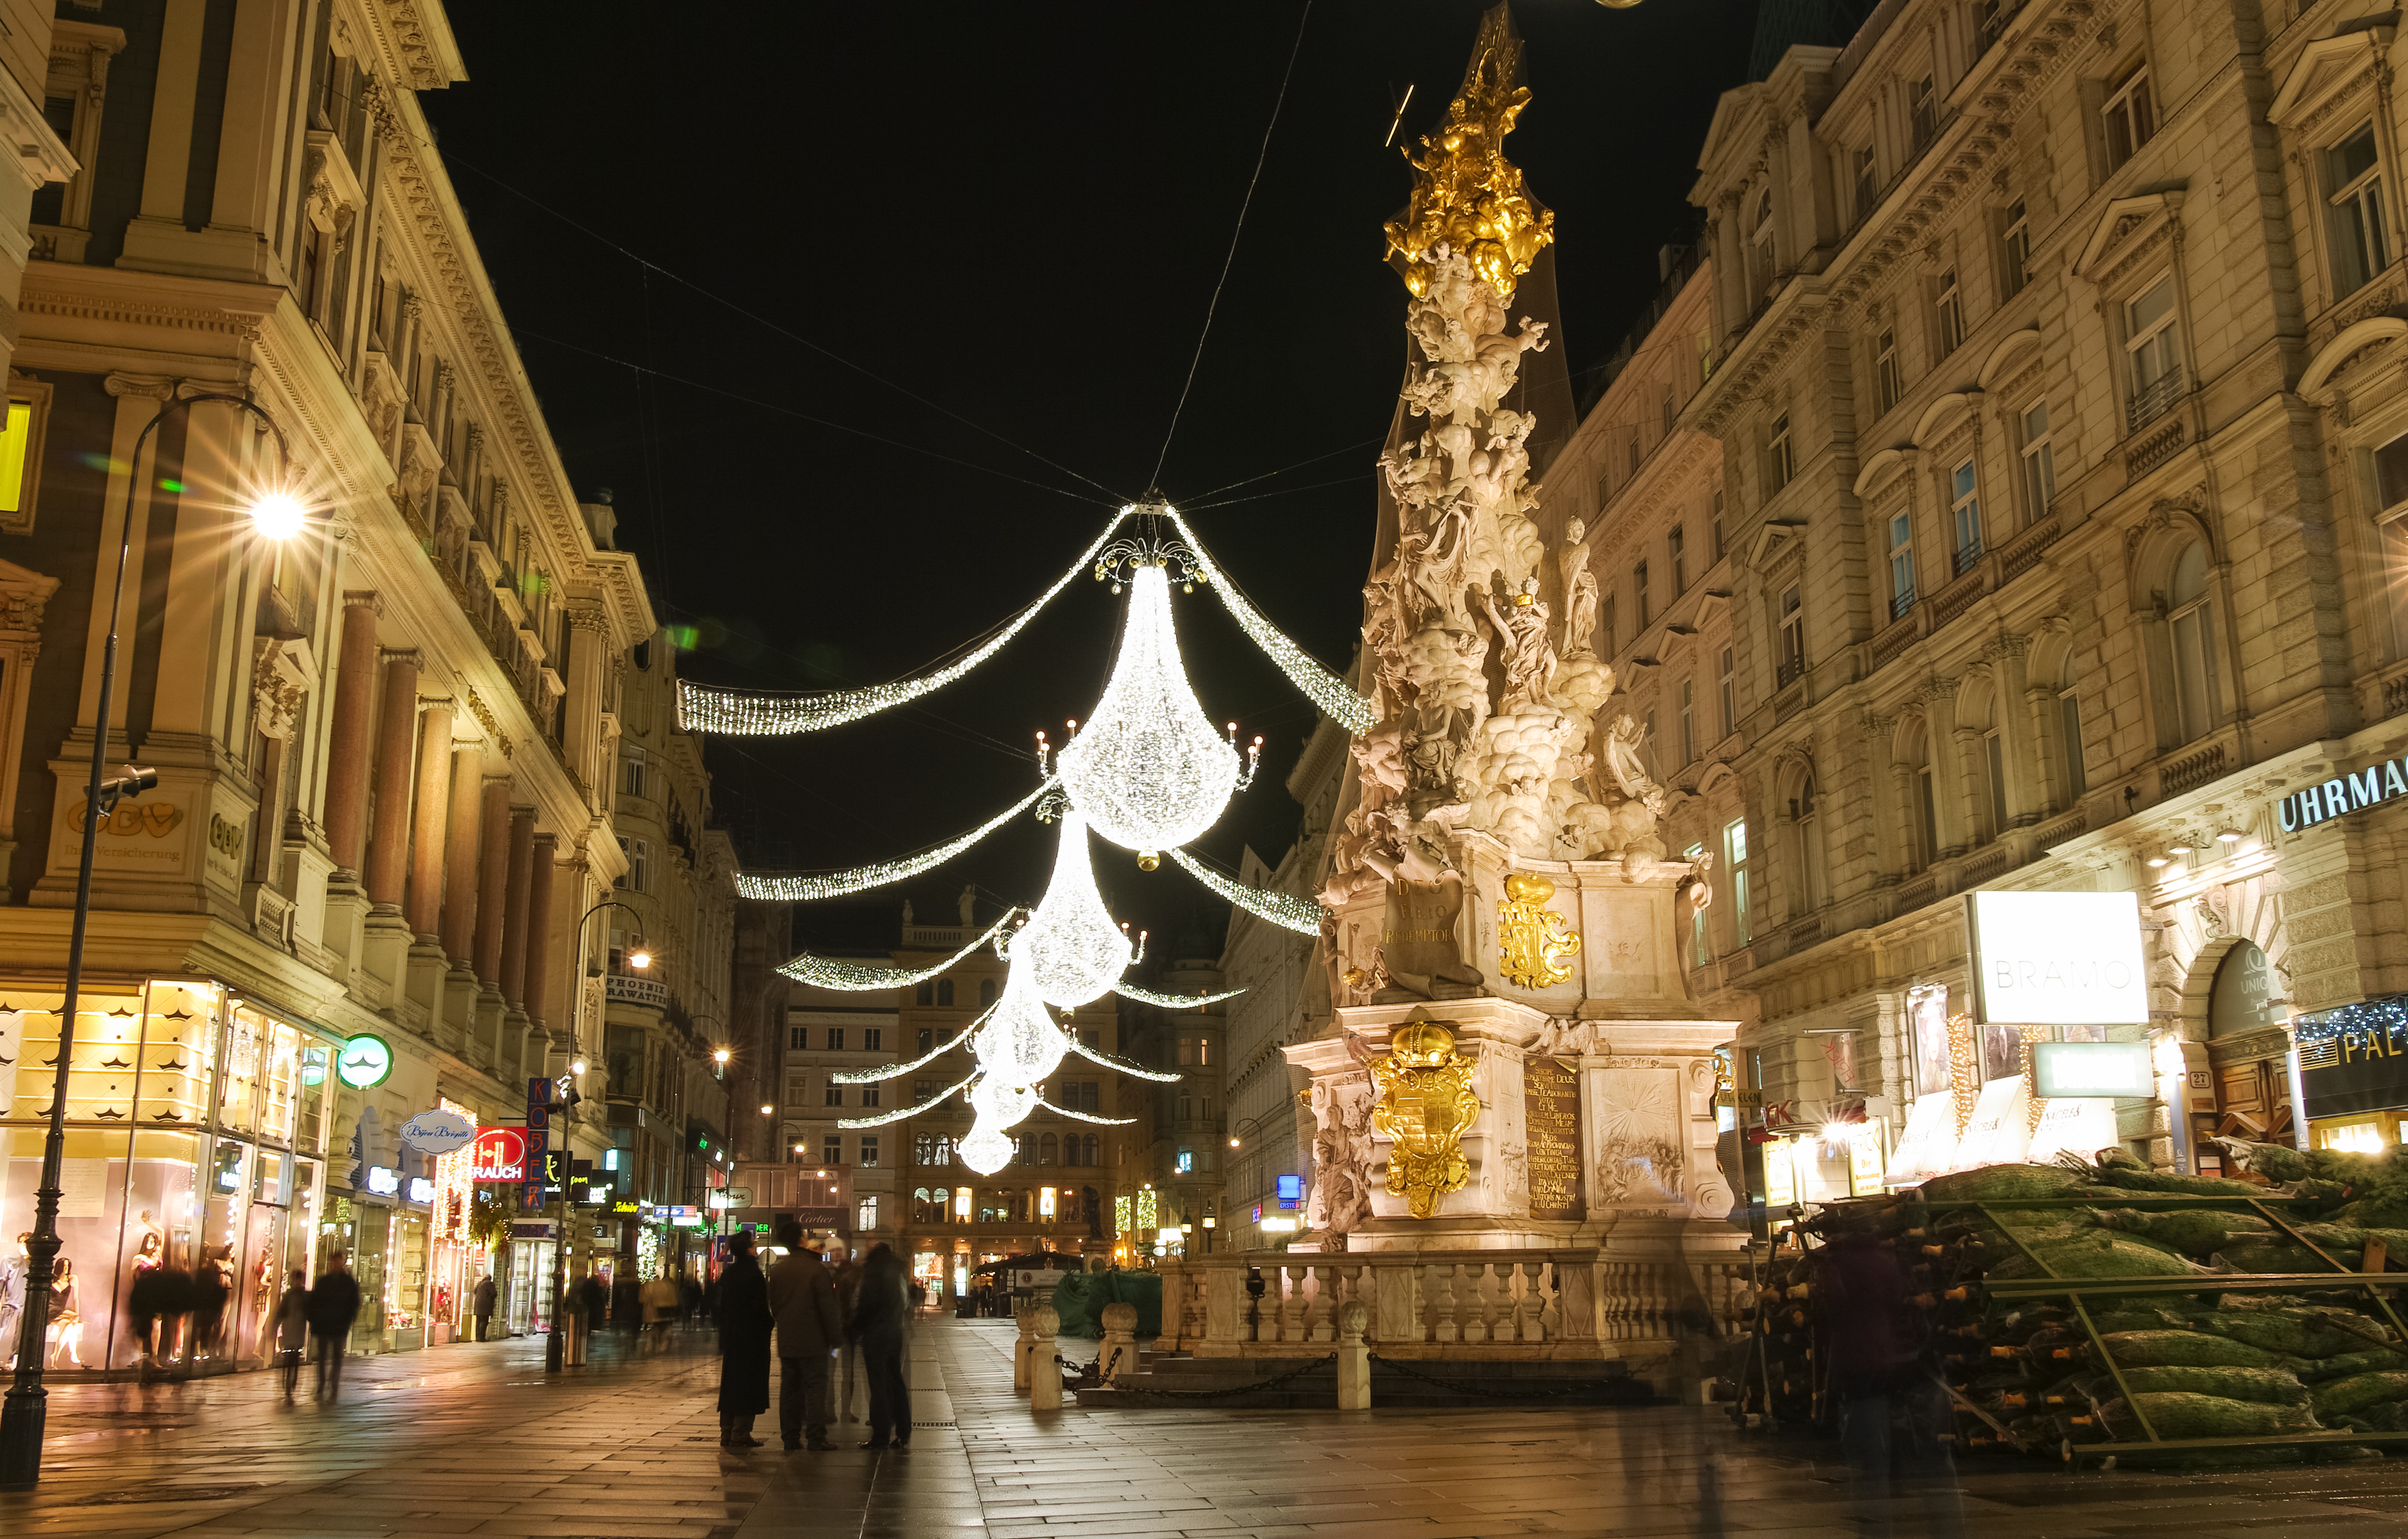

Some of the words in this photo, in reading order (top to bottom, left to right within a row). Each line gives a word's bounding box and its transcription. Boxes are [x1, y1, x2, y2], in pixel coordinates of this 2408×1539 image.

[2278, 755, 2408, 832] UHRMA
[95, 846, 180, 862] Versicherung
[1397, 878, 1443, 895] DEO
[1400, 905, 1446, 919] FILIO
[1996, 961, 2131, 988] BRAMO
[607, 978, 664, 994] PHOENIX
[2241, 974, 2276, 994] UNIQA
[607, 988, 667, 1005] RAWATTEN
[2343, 1025, 2408, 1064] PAL
[2194, 1073, 2206, 1083] 27
[407, 1125, 433, 1139] Bijou
[528, 1081, 547, 1207] KOBER
[1862, 1159, 1871, 1168] Die
[473, 1166, 523, 1179] RAUCH
[799, 1213, 836, 1224] Cartier
